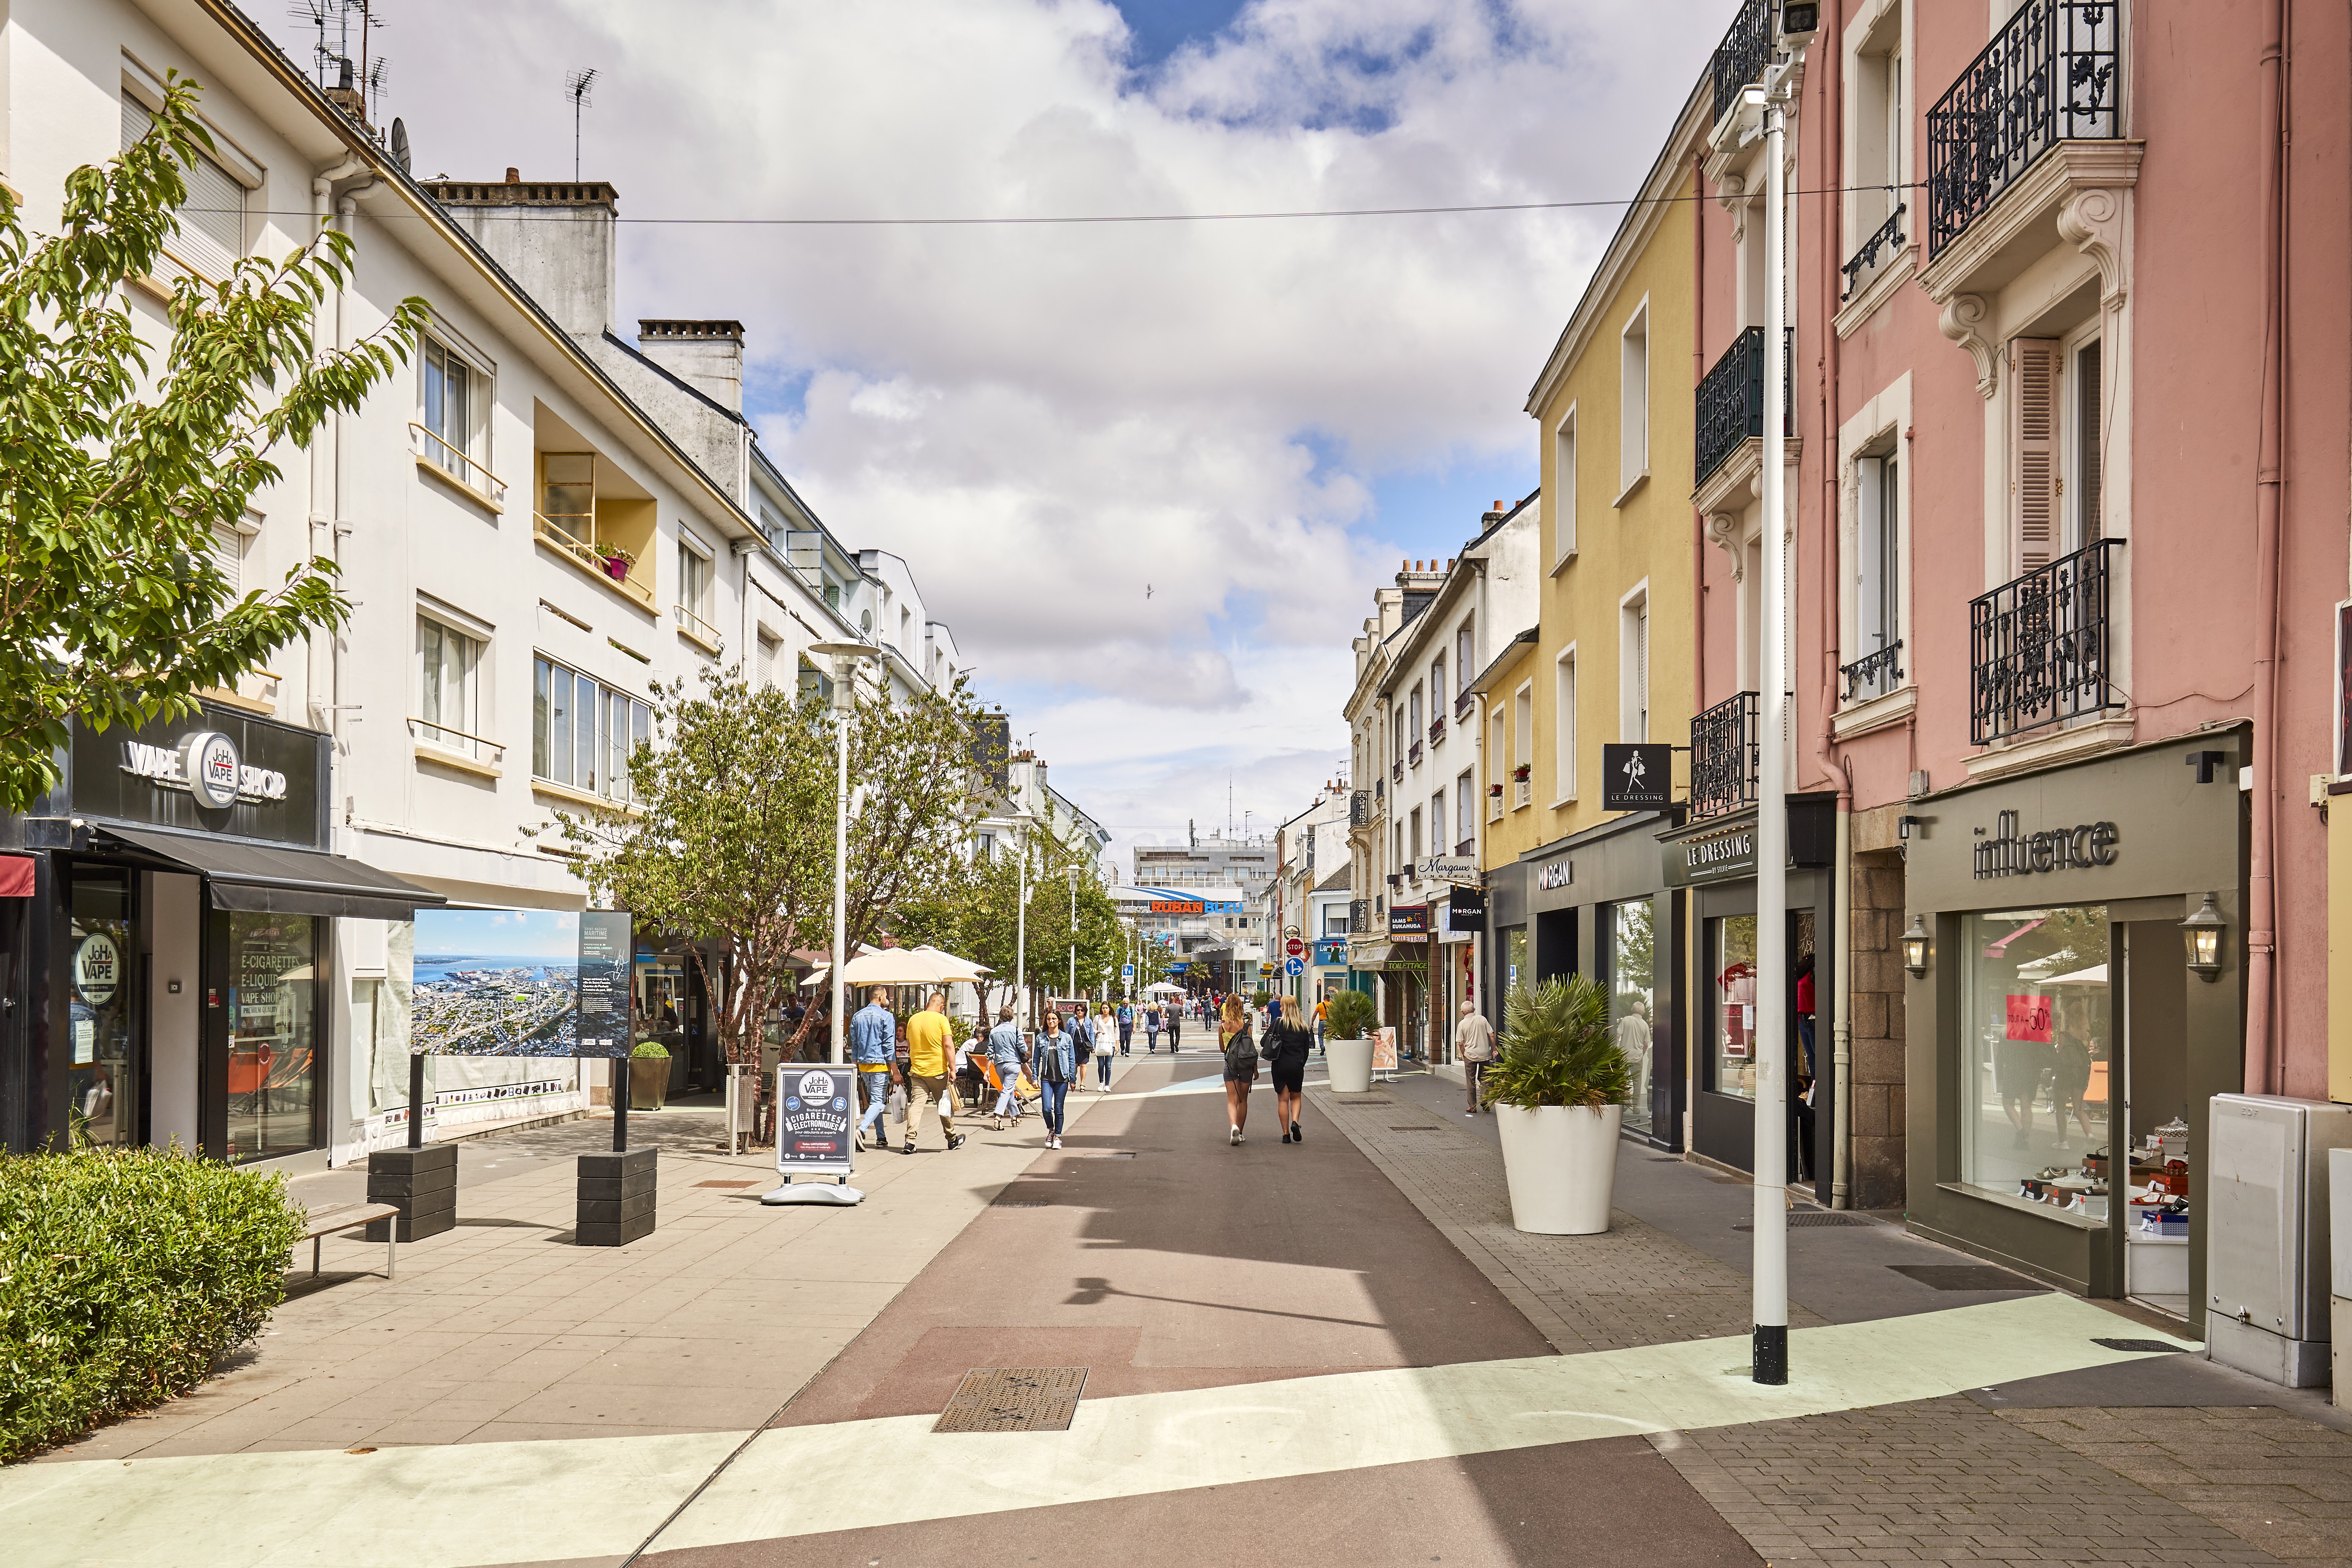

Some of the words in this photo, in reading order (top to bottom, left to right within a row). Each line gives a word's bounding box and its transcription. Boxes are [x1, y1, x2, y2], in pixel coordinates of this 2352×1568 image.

[128, 741, 181, 781] VAPE
[240, 765, 286, 800] SHOP
[208, 760, 232, 782] VAPE
[1687, 847, 1698, 866] LE
[1701, 834, 1751, 863] DRESSING
[1974, 810, 2113, 879] influence
[1418, 858, 1470, 875] Margaux
[1717, 865, 1728, 873] SYLVIE
[1538, 860, 1570, 891] MORGAN
[1151, 901, 1203, 913] RUBAN
[1204, 902, 1242, 913] BLEU
[82, 960, 112, 979] VAPE
[242, 955, 301, 972] E-CIGARETTES
[241, 993, 259, 1004] VAPE
[261, 992, 280, 1003] SHOP
[2025, 1008, 2050, 1030] -50%
[804, 1084, 827, 1093] VAPE
[790, 1112, 842, 1123] CIGARETTES
[2241, 1107, 2259, 1117] EDF
[793, 1120, 839, 1131] ELECTRONIQUES
